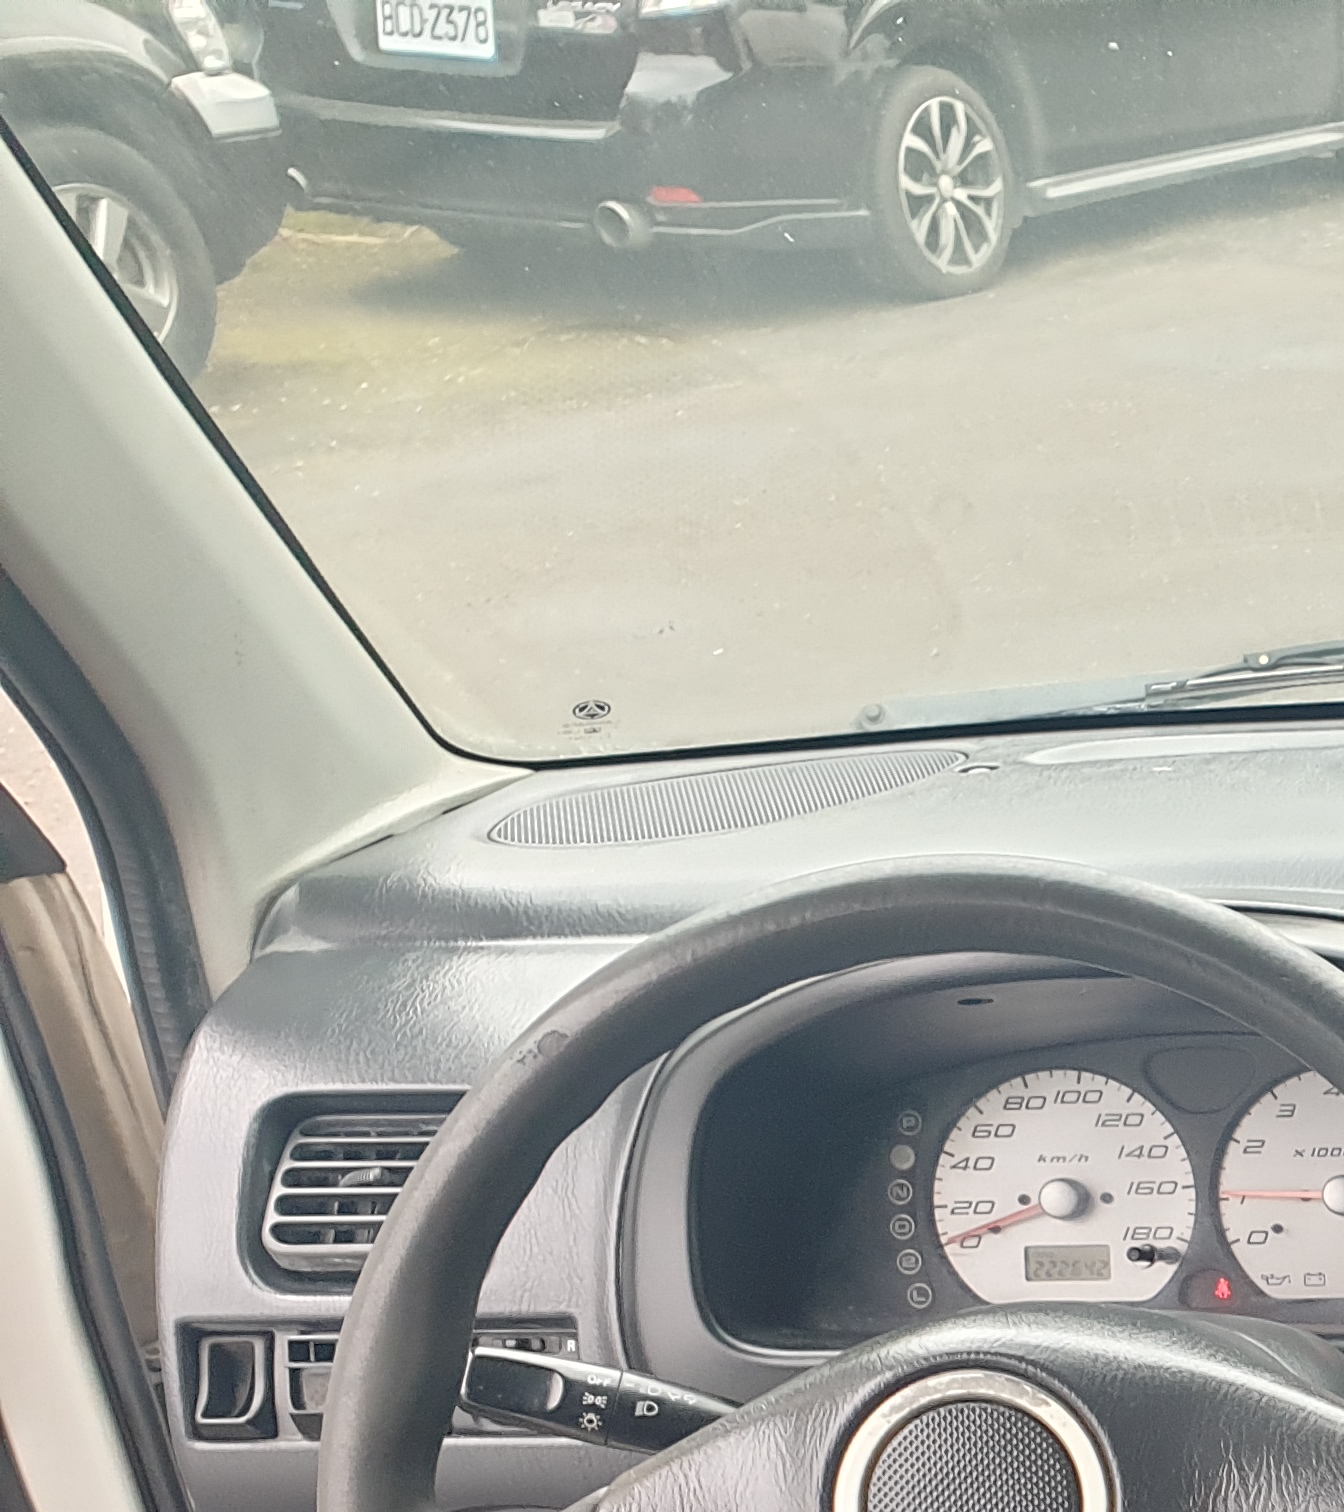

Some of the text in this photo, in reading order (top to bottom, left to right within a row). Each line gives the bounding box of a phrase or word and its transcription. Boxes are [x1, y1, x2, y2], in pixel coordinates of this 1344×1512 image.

[381, 0, 490, 44] BCD-2378
[1003, 1096, 1046, 1110] 80
[1053, 1090, 1103, 1104] 100
[1276, 1103, 1296, 1118] 3
[1095, 1113, 1144, 1127] 120
[971, 1123, 1016, 1138] 60
[1118, 1145, 1169, 1159] 140
[1243, 1139, 1266, 1154] 2
[950, 1156, 995, 1171] 40
[1037, 1154, 1089, 1163] km/h
[1127, 1181, 1178, 1195] 160
[950, 1200, 995, 1215] 20
[1123, 1226, 1174, 1241] 180
[1247, 1230, 1269, 1244] 0
[960, 1234, 982, 1249] 0
[567, 1340, 575, 1351] R
